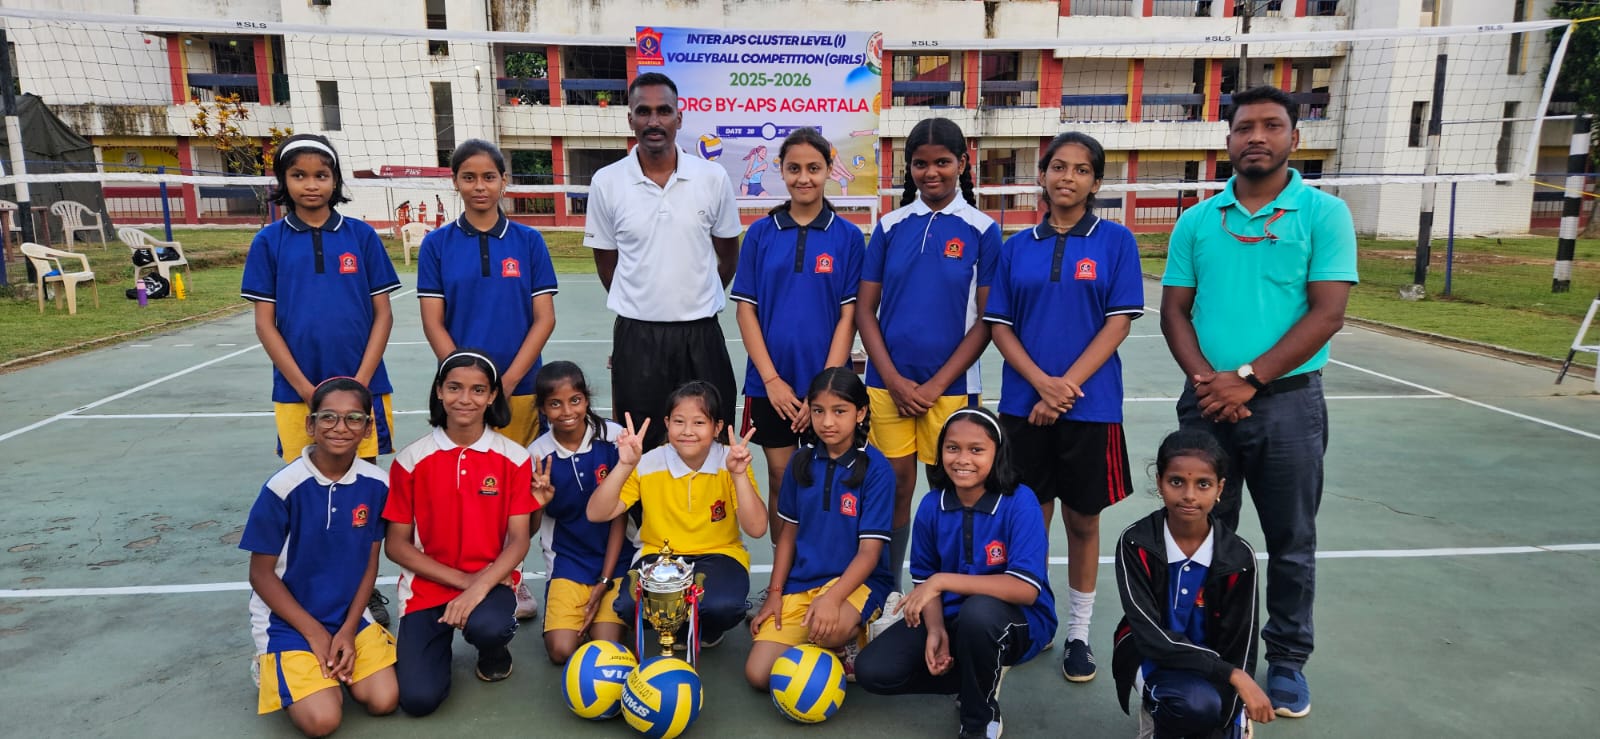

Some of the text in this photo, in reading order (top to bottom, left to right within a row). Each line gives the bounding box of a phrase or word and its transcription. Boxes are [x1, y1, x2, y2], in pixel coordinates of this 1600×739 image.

[686, 33, 847, 48] INTER APS CLUSTER LEVEL (I)
[667, 52, 867, 66] VOLLEYBALL COMPETITION (GIRLS)
[729, 73, 812, 87] 2025-2026
[677, 97, 870, 113] ORG BY-APS AGARTALA
